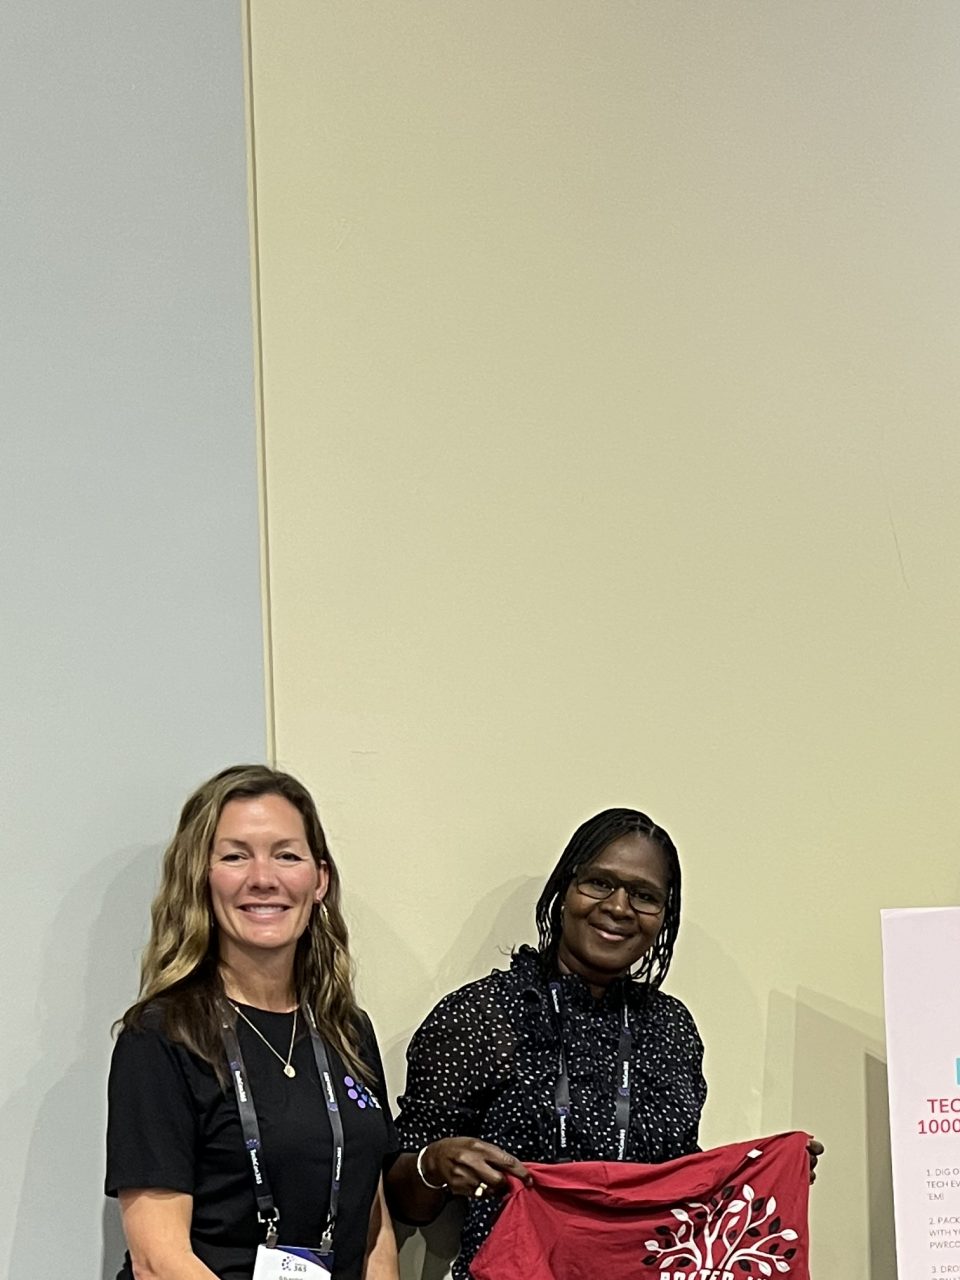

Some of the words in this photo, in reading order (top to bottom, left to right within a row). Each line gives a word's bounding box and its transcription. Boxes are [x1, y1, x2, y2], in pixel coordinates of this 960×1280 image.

[935, 1168, 951, 1176] DIG
[926, 1180, 949, 1188] TECH
[937, 1216, 960, 1225] PACK
[929, 1229, 951, 1237] WITH
